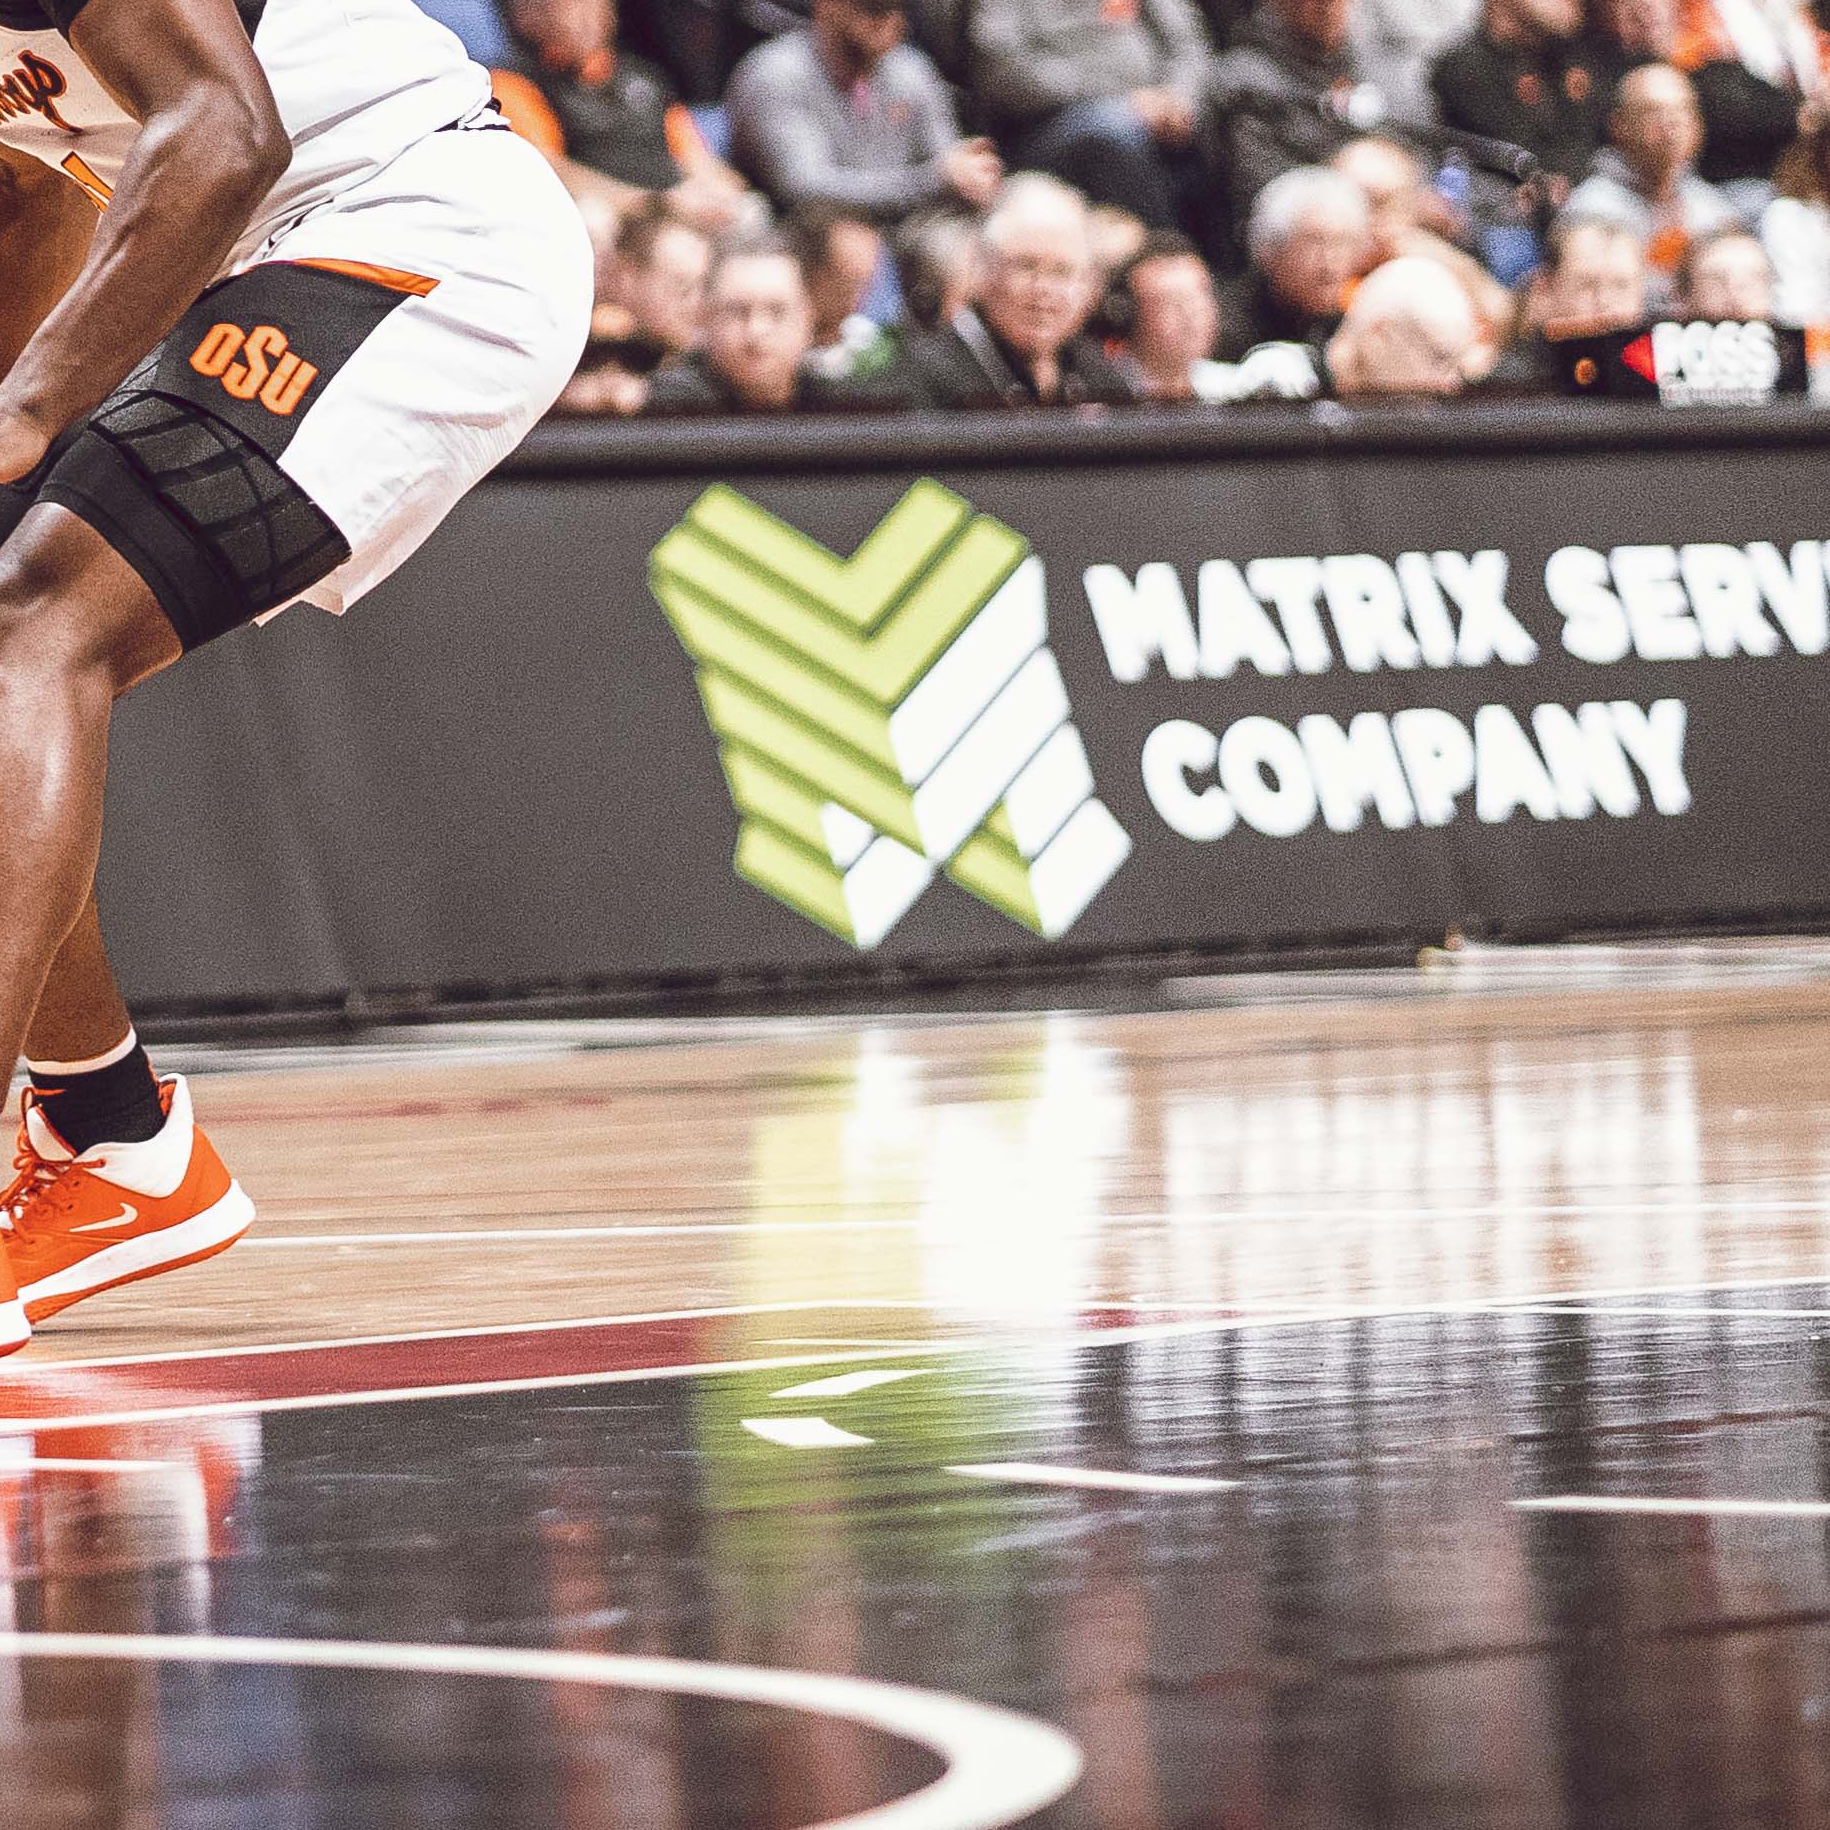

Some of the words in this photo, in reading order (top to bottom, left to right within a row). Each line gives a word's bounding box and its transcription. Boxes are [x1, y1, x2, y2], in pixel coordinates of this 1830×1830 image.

[189, 322, 320, 416] OSU
[1081, 548, 1539, 684] MATRIX
[1543, 539, 1830, 665] SERV
[1140, 697, 1691, 843] COMPANY
